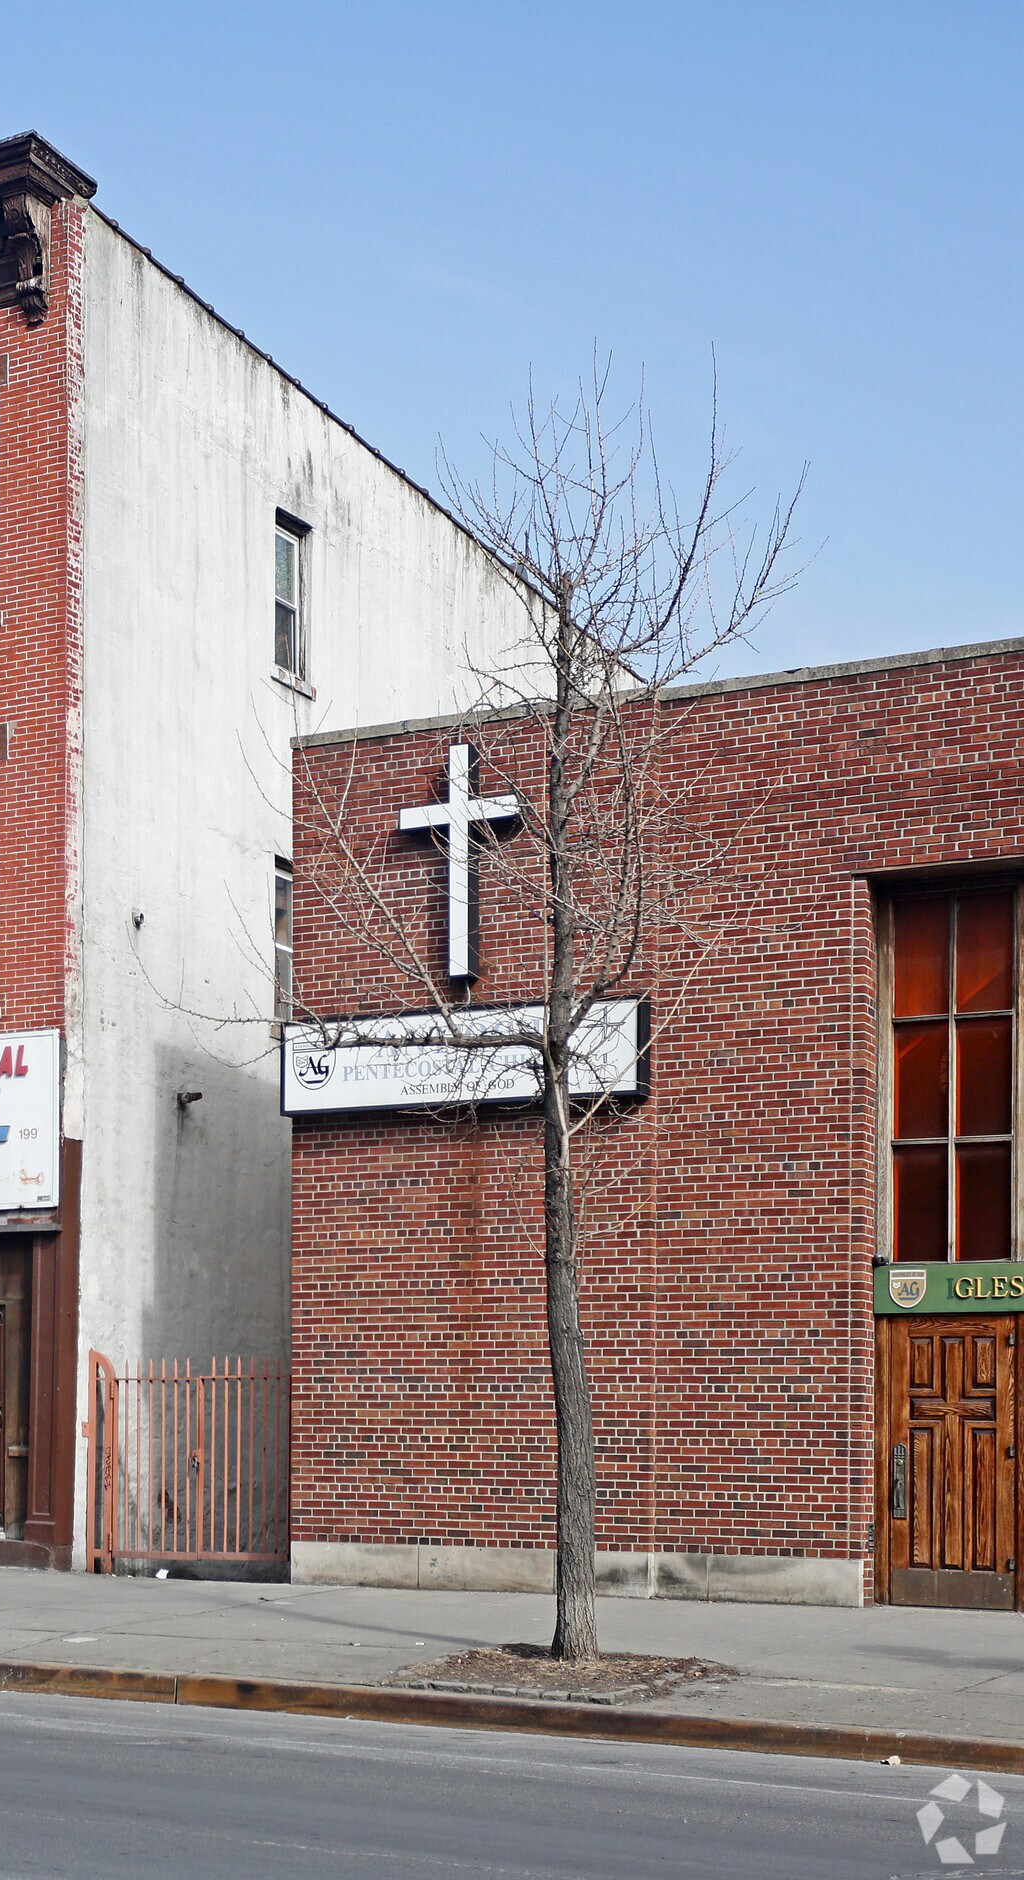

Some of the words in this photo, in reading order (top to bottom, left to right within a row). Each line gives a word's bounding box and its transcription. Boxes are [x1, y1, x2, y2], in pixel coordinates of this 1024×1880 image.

[400, 1082, 459, 1097] ASSEMBLY
[467, 1080, 481, 1092] OF
[489, 1078, 515, 1091] GOD
[18, 1128, 39, 1140] 199
